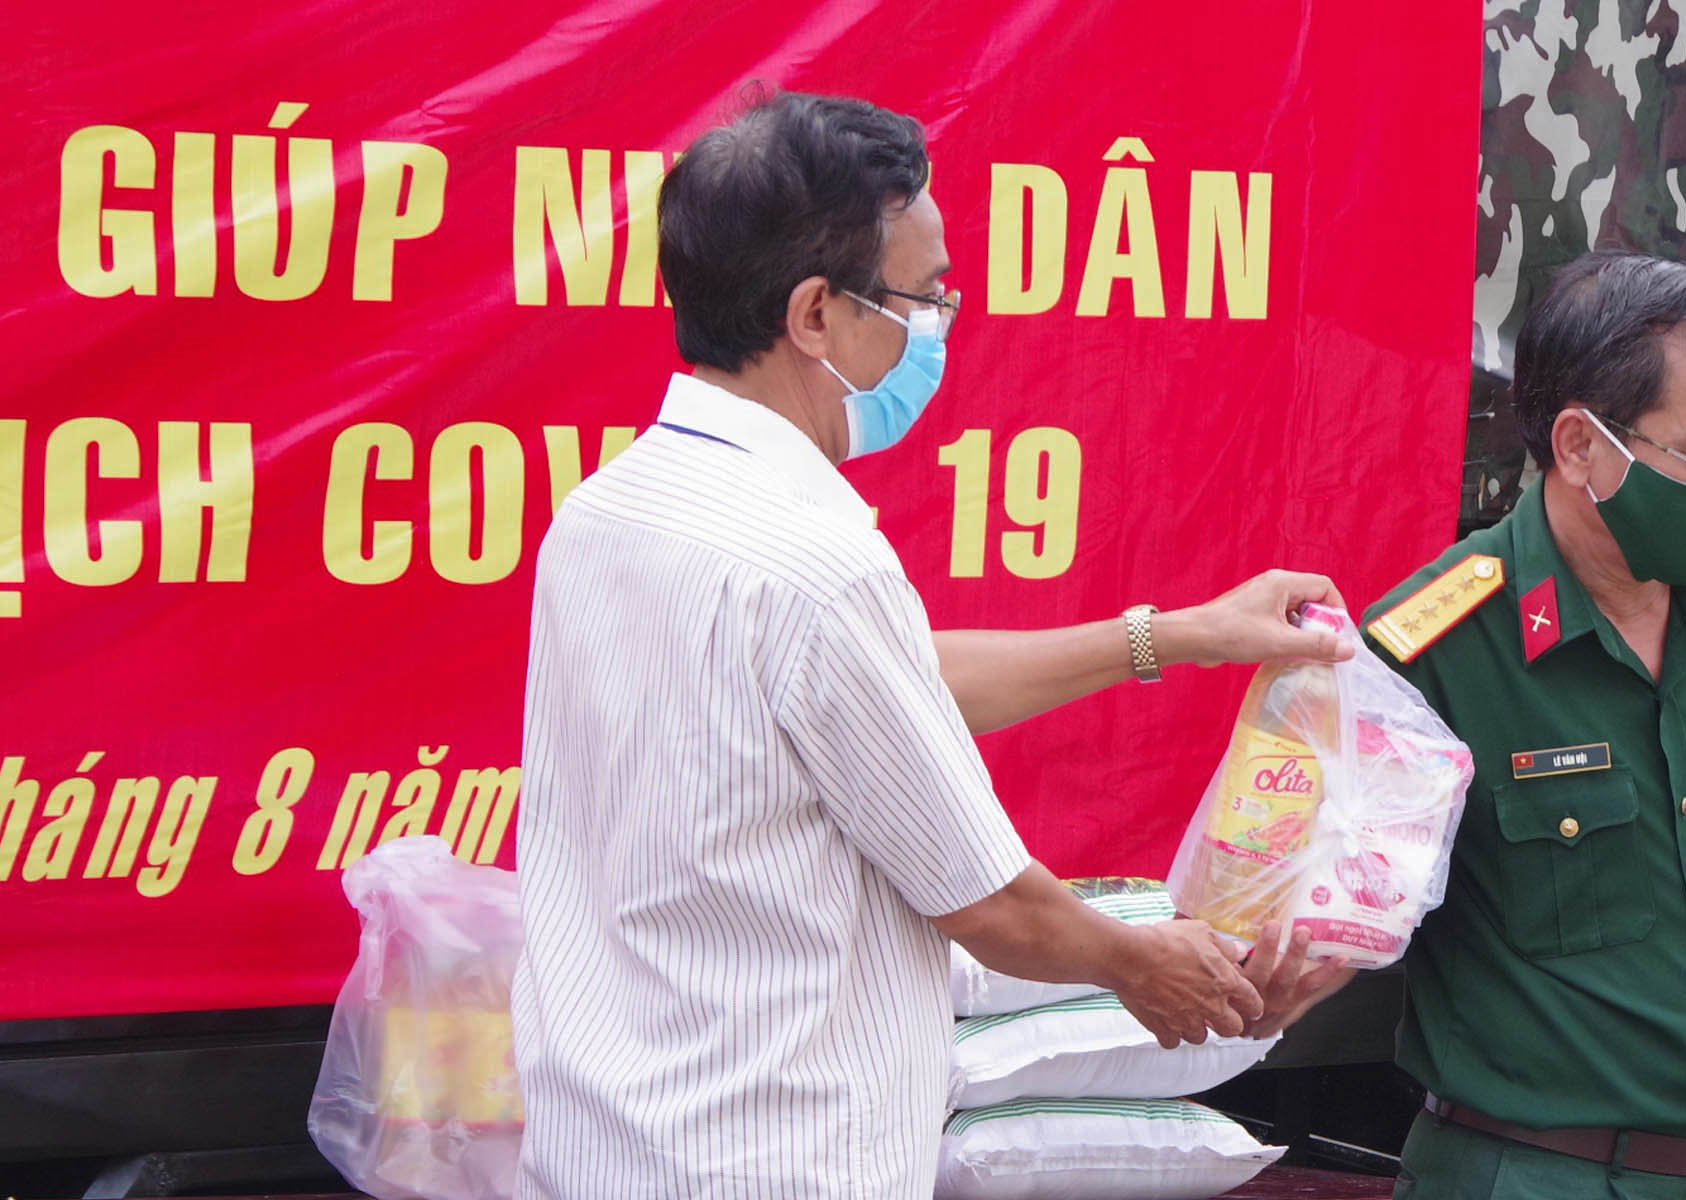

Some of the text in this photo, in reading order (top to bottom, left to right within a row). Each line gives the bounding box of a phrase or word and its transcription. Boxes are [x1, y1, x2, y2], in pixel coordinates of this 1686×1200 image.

[57, 102, 448, 302] GIÚP
[986, 136, 1273, 319] DÂN
[232, 747, 314, 875] 8
[316, 745, 522, 870] năm
